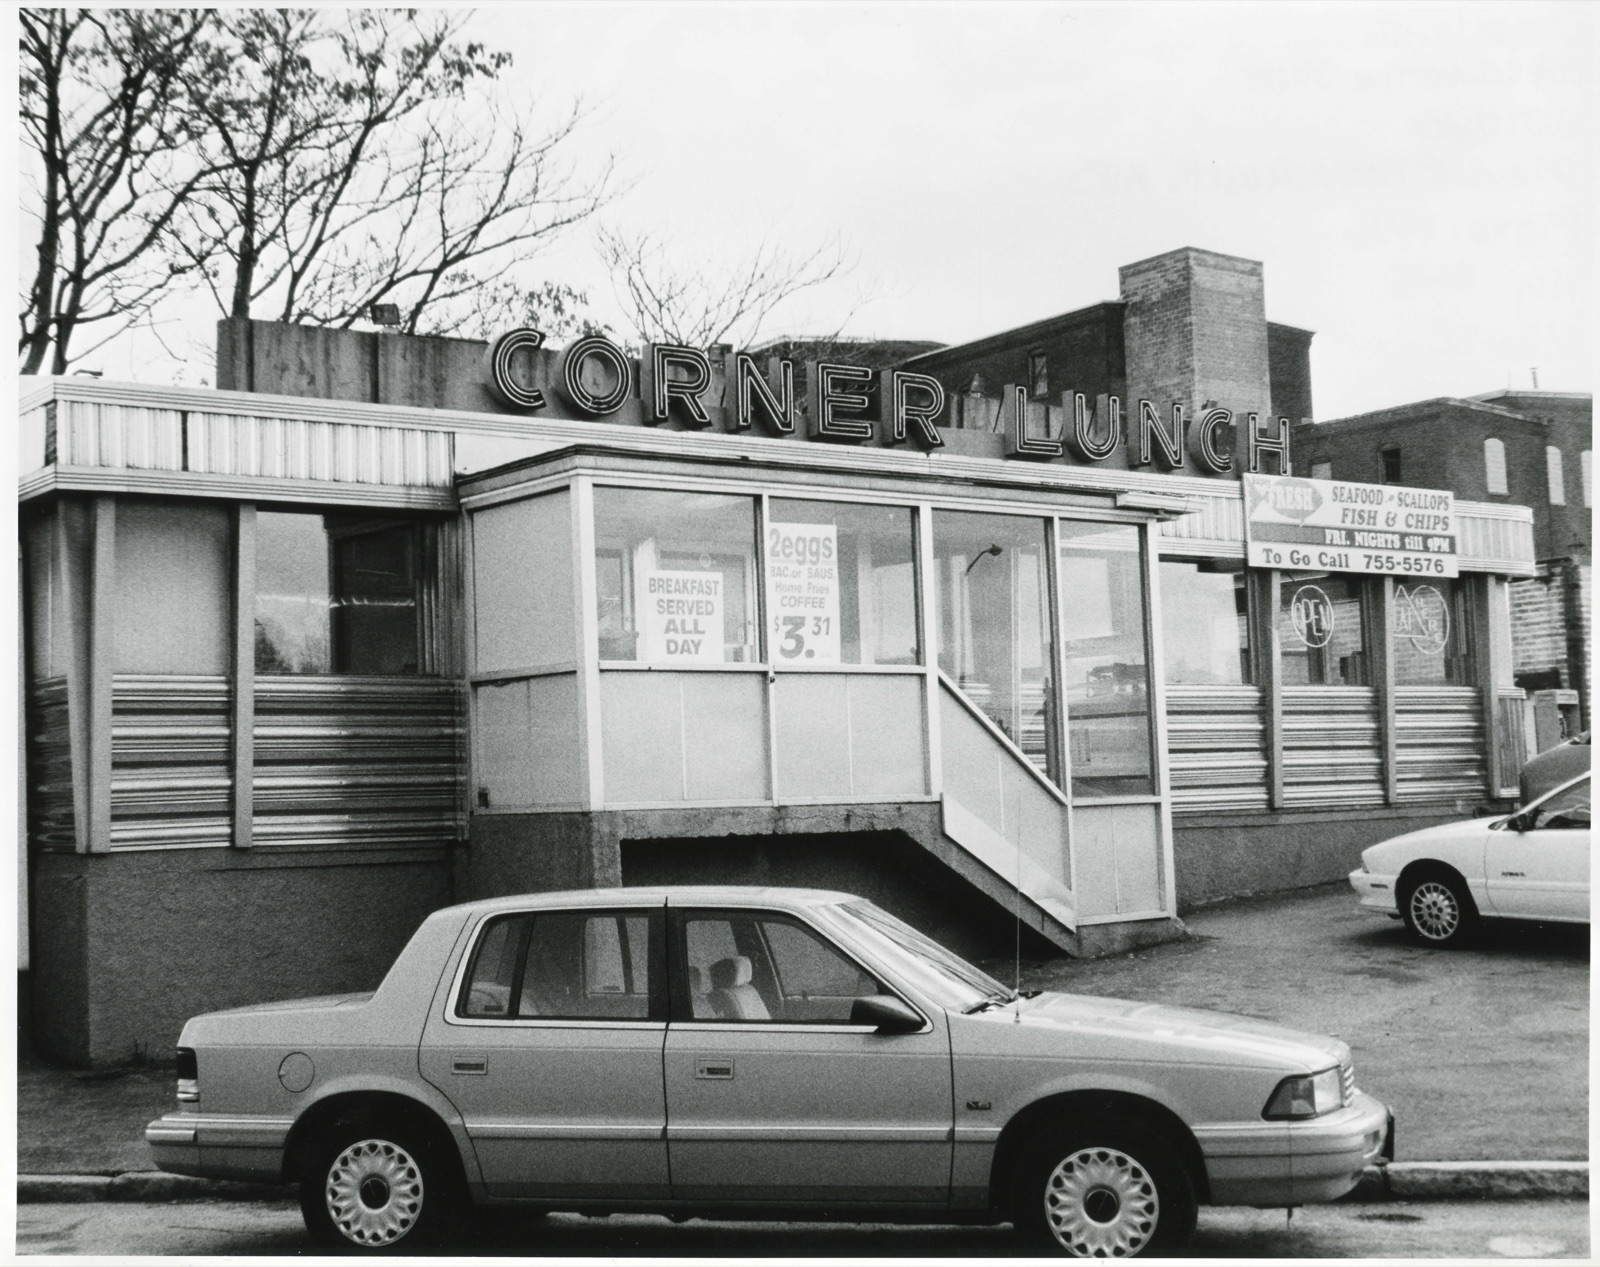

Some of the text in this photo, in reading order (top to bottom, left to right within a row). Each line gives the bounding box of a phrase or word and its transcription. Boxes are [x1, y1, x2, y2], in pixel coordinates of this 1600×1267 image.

[491, 328, 1291, 476] CORNER LUNCH
[1268, 485, 1314, 510] FRESH
[1332, 487, 1450, 511] SEAFOOD SCALLOPS
[1340, 508, 1450, 531] FISH & CHIPS
[1324, 529, 1451, 553] FRI. NIGHTS till 9PM
[1262, 548, 1445, 574] To Go Call 755-5576
[648, 577, 720, 596] BREAKFAST
[774, 581, 830, 595] Home Fries
[656, 599, 715, 616] SERVED
[781, 595, 826, 609] COFFEE
[664, 618, 706, 635] ALL
[1294, 598, 1332, 636] OPEN
[665, 639, 703, 655] DAY
